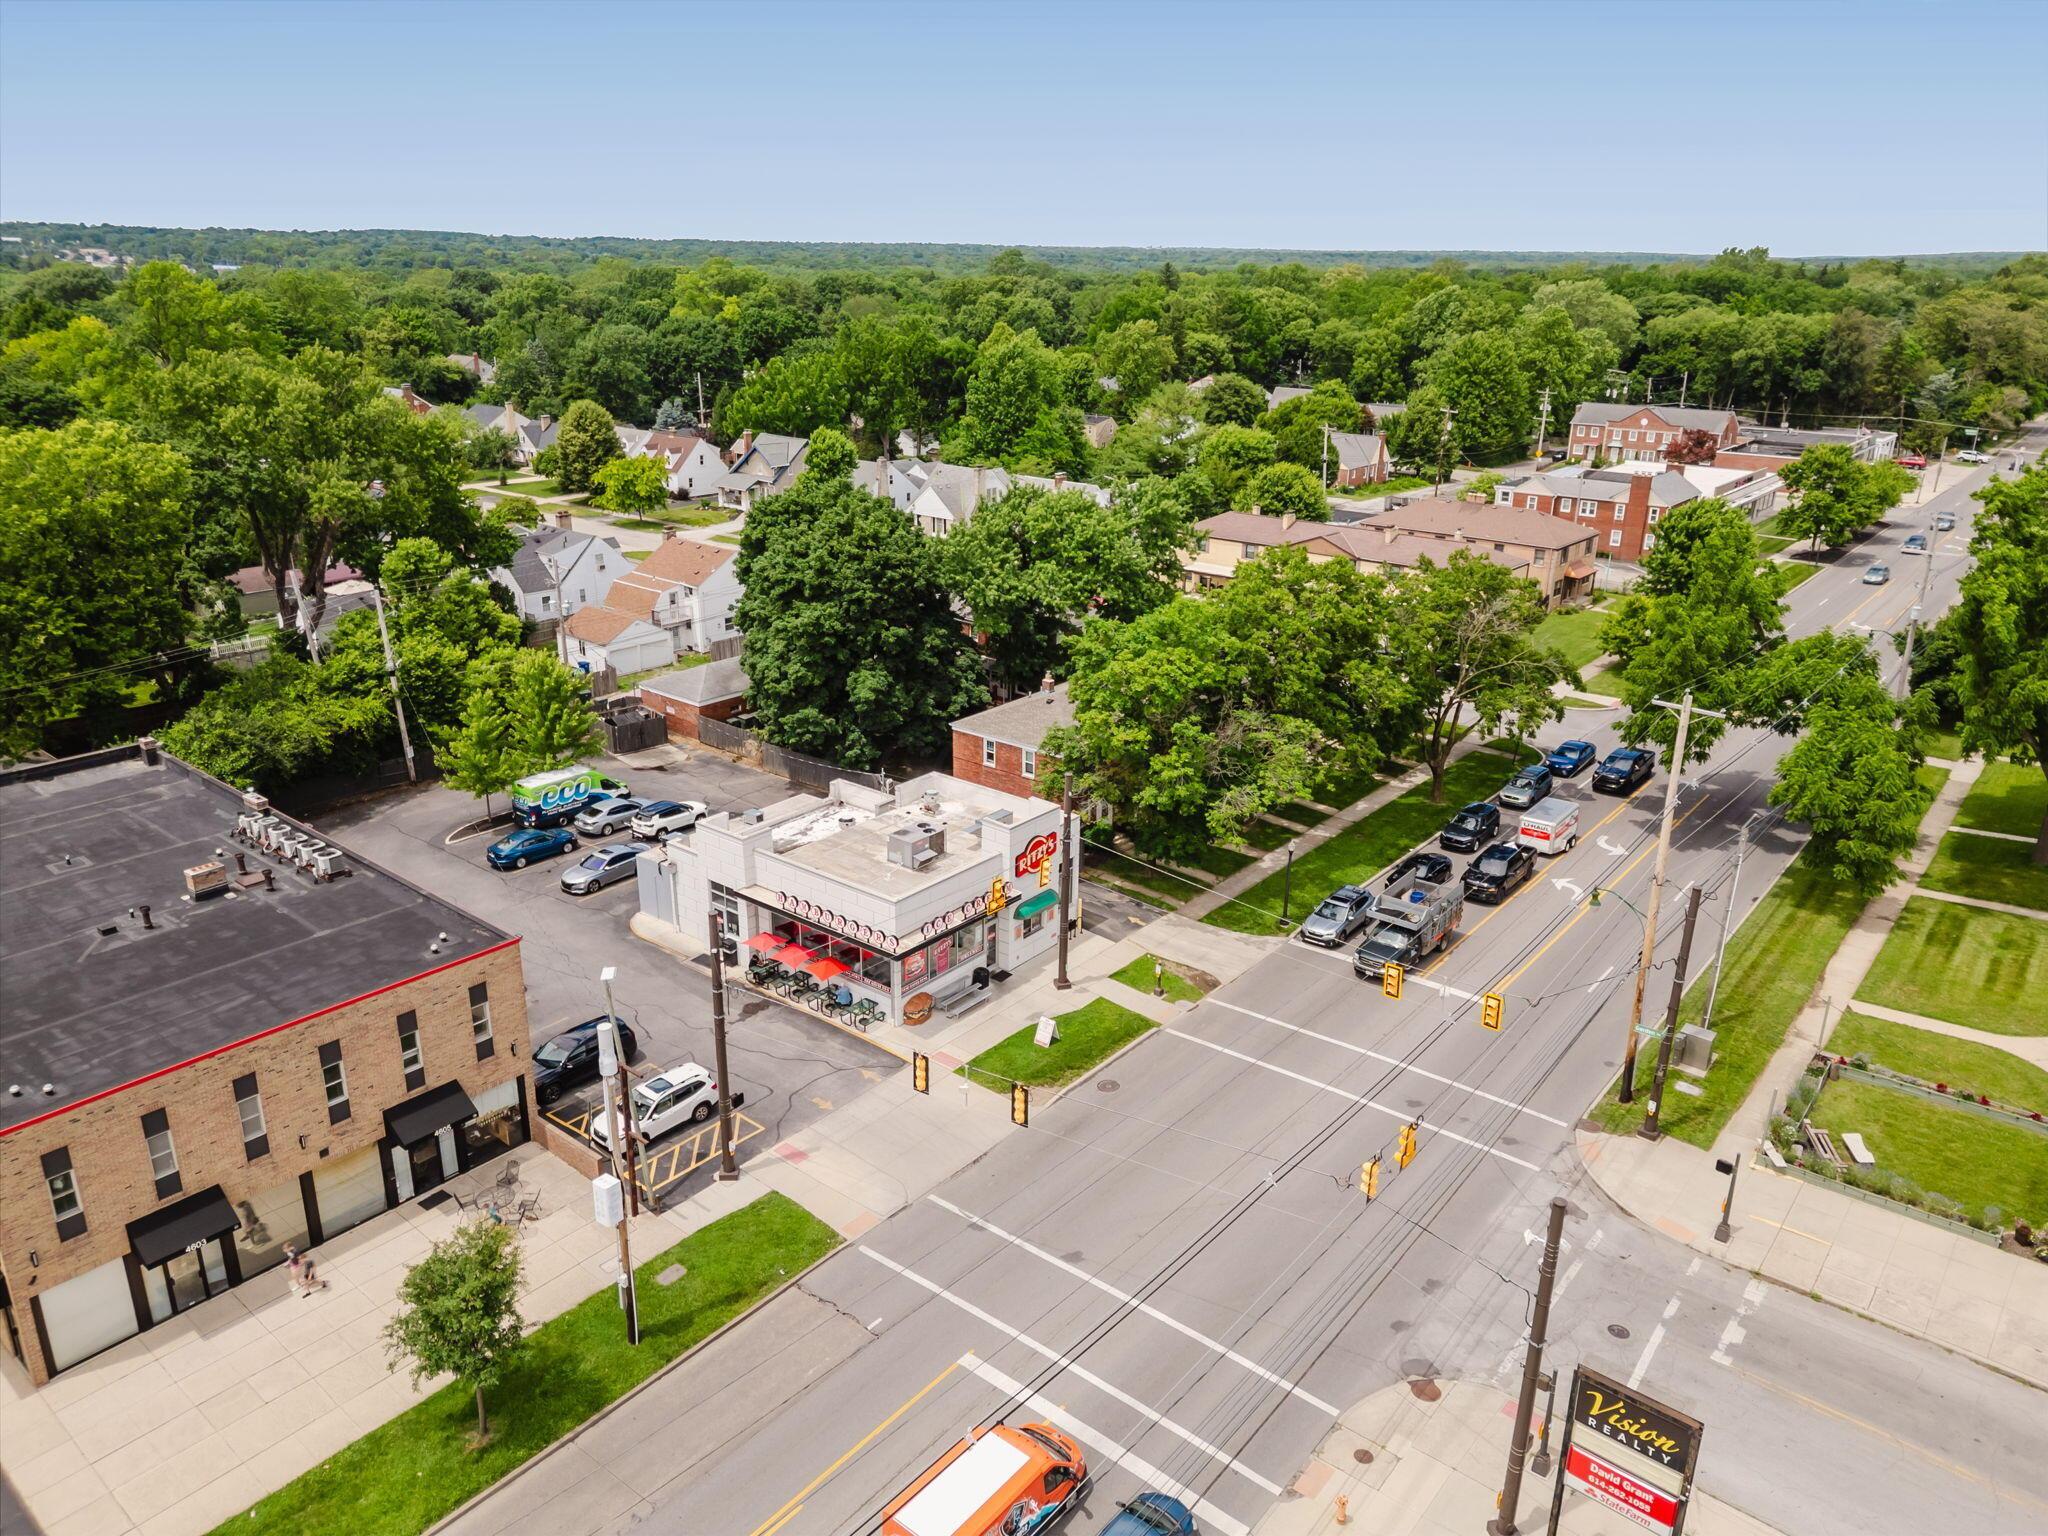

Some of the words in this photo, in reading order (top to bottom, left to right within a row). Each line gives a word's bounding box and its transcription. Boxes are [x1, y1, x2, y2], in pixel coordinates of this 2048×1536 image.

[541, 776, 592, 809] eco
[1019, 837, 1055, 872] RITZY'S
[776, 892, 898, 948] HAMBURGERS
[923, 911, 955, 935] ICE
[964, 883, 1013, 913] CREM
[185, 1239, 207, 1253] 4603
[1586, 1391, 1680, 1453] Vision
[1588, 1417, 1671, 1464] REALTY
[1590, 1462, 1621, 1485] David
[1622, 1480, 1655, 1503] Grant
